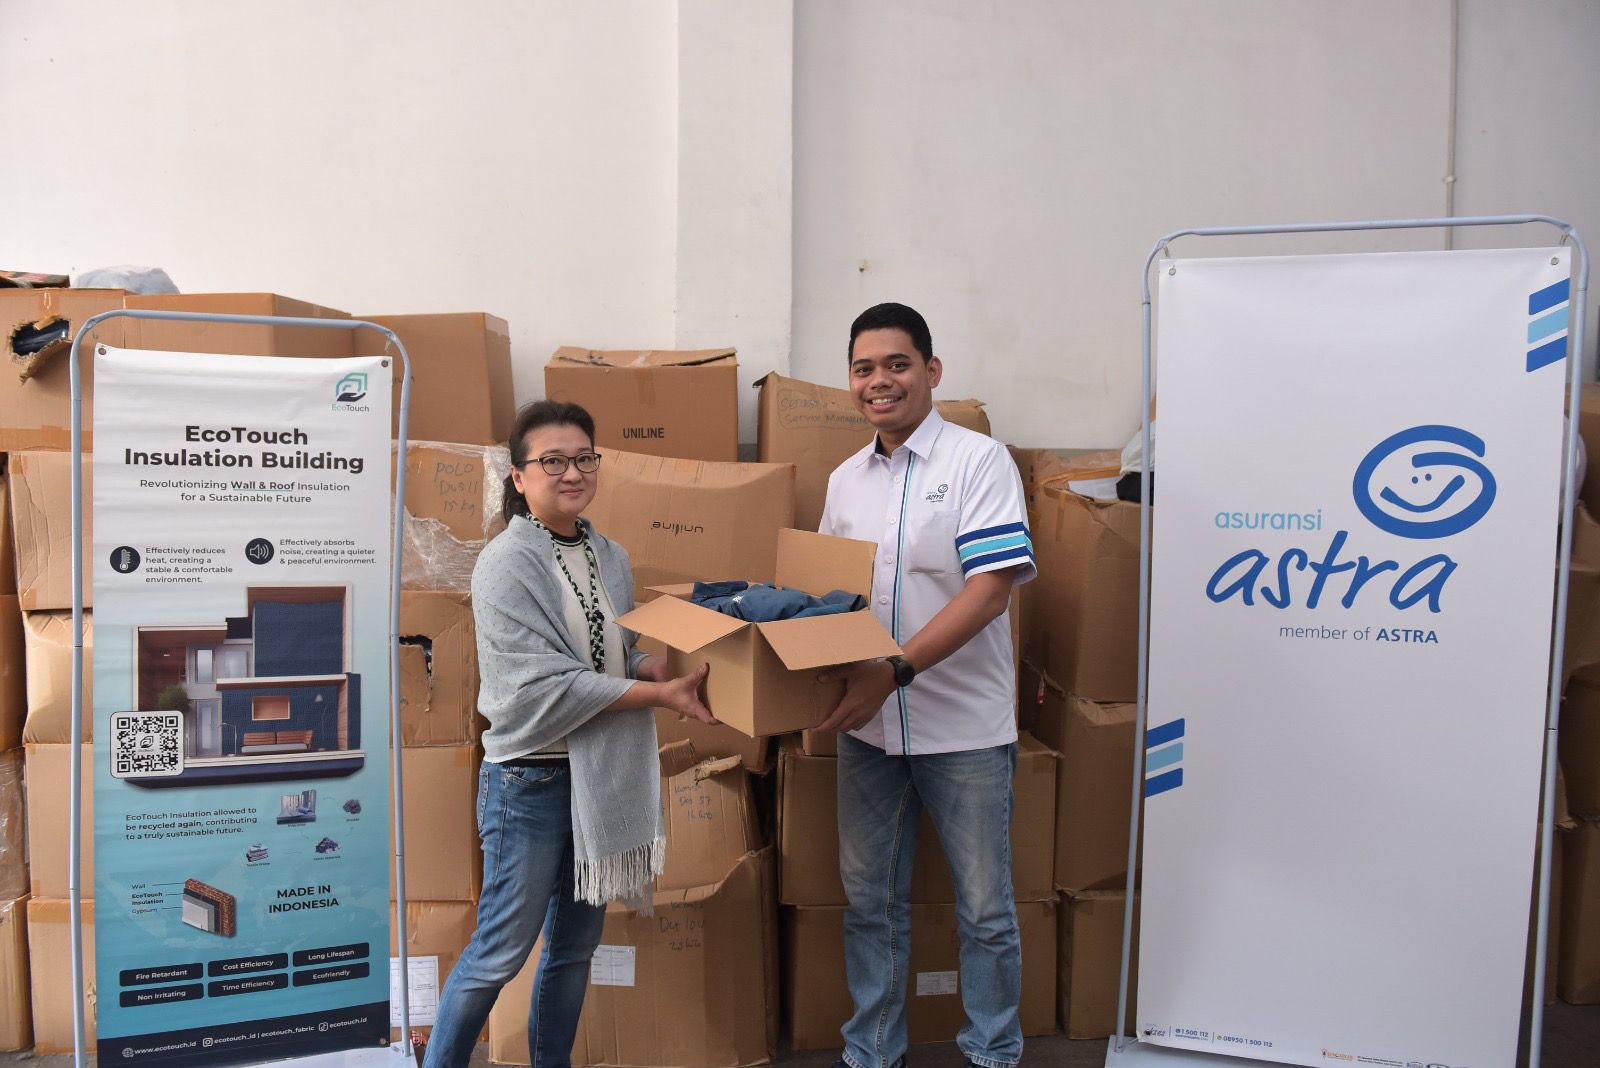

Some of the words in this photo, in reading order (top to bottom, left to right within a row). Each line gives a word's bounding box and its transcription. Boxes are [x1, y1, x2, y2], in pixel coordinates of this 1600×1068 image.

[332, 404, 370, 412] EcoTouch
[185, 425, 308, 445] EcoTouch
[623, 427, 665, 439] UNILINE
[124, 448, 253, 468] Insulation
[261, 450, 364, 474] Building
[140, 479, 228, 490] Revolutionizing
[231, 480, 256, 490] Wall
[258, 482, 266, 490] &
[270, 481, 295, 490] Roof
[298, 482, 350, 492] Insulation
[181, 492, 196, 502] for
[209, 493, 273, 503] Sustainable
[276, 494, 312, 503] Future
[1214, 508, 1322, 530] asuransi
[652, 521, 704, 536] uniline
[280, 538, 322, 547] Effectively
[146, 546, 190, 555] Effectively
[305, 548, 339, 556] creating
[347, 548, 376, 556] quieter
[169, 557, 204, 565] creating
[288, 558, 322, 566] peaceful
[1206, 530, 1458, 614] astra
[1279, 625, 1348, 640] member
[1353, 626, 1371, 641] of
[1376, 628, 1439, 644] ASTRA
[126, 812, 168, 821] EcoTouch
[170, 810, 212, 819] Insulation
[214, 808, 246, 816] allowed
[139, 822, 176, 832] recycled
[178, 820, 204, 829] again,
[206, 816, 258, 826] contributing
[144, 832, 164, 840] truly
[166, 828, 214, 838] sustainable
[216, 827, 244, 835] future.
[277, 886, 315, 899] MADE
[318, 884, 331, 895] IN
[269, 898, 339, 913] INDONESIA
[308, 954, 325, 962] Long
[326, 949, 355, 960] Lifespan
[222, 962, 238, 971] Cost
[240, 959, 274, 969] Efficiency
[151, 969, 188, 979] Retardant
[312, 969, 350, 980] Ecofriendly
[222, 983, 240, 991] Time
[241, 979, 274, 989] Efficiency
[154, 990, 186, 1000] Irritating
[330, 1017, 367, 1029] ecotouch.id
[261, 1025, 315, 1038] ecotouch_fabric
[134, 1040, 197, 1055] www.ecotouch.id
